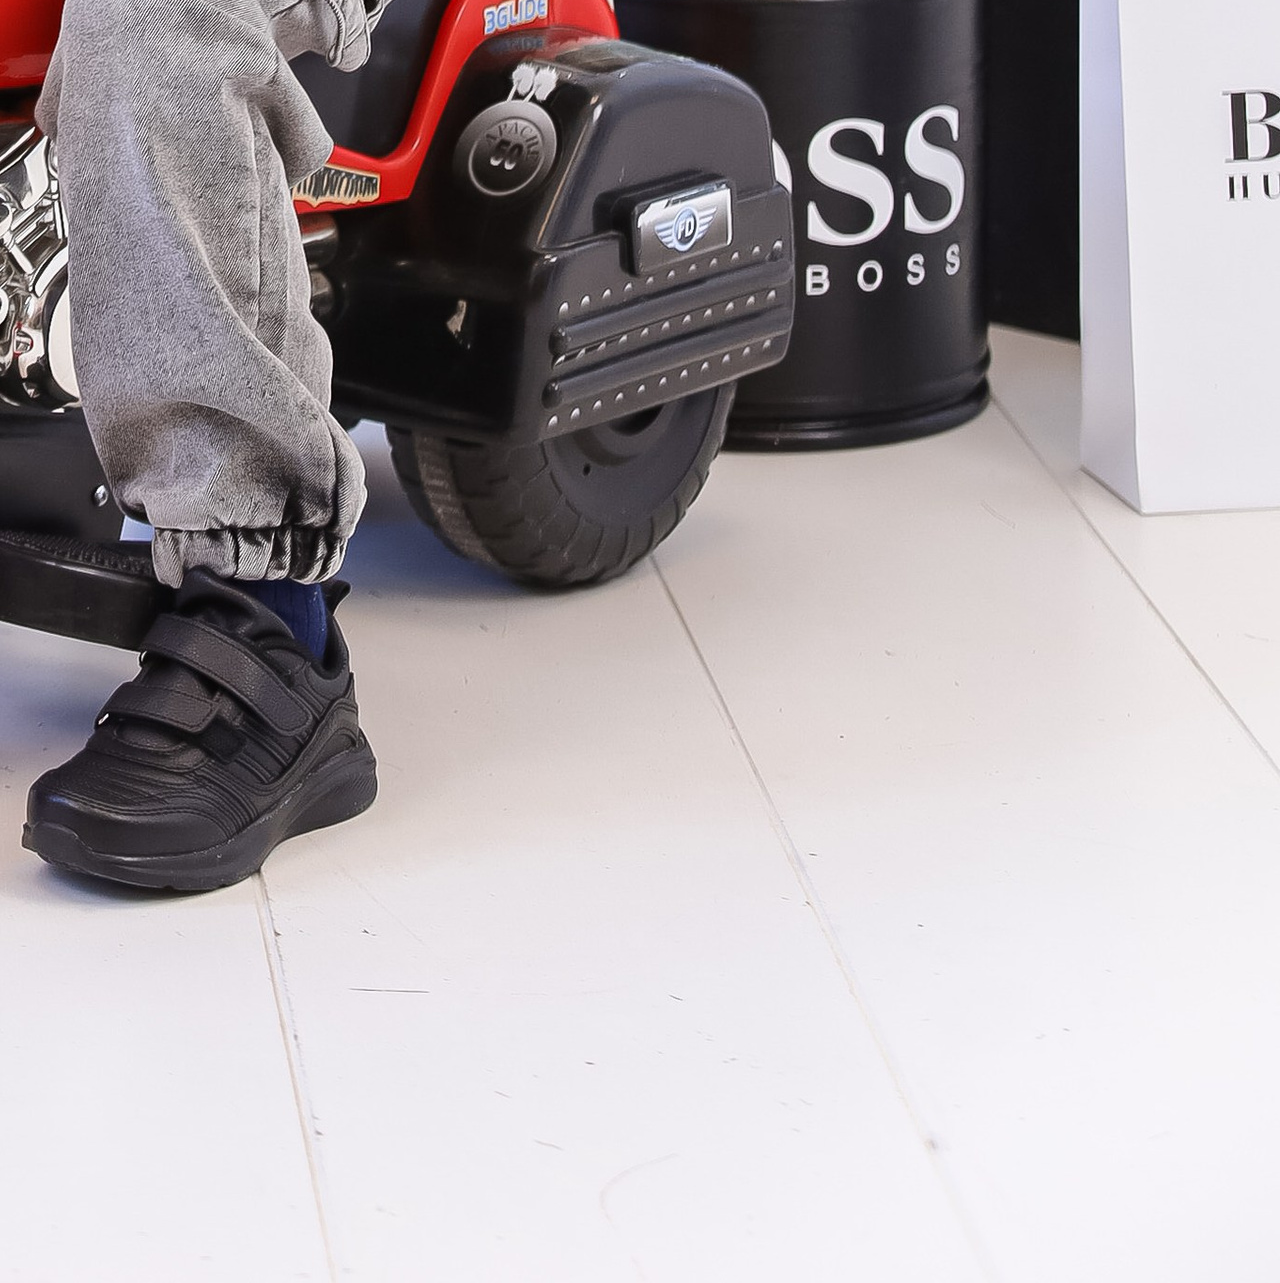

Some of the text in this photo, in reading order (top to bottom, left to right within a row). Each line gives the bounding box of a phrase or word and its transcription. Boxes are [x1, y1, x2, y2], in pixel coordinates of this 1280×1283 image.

[485, 121, 540, 162] APACHE
[489, 138, 524, 170] 50
[772, 104, 966, 246] SS
[1226, 172, 1280, 202] HU
[805, 243, 961, 296] BOSS
